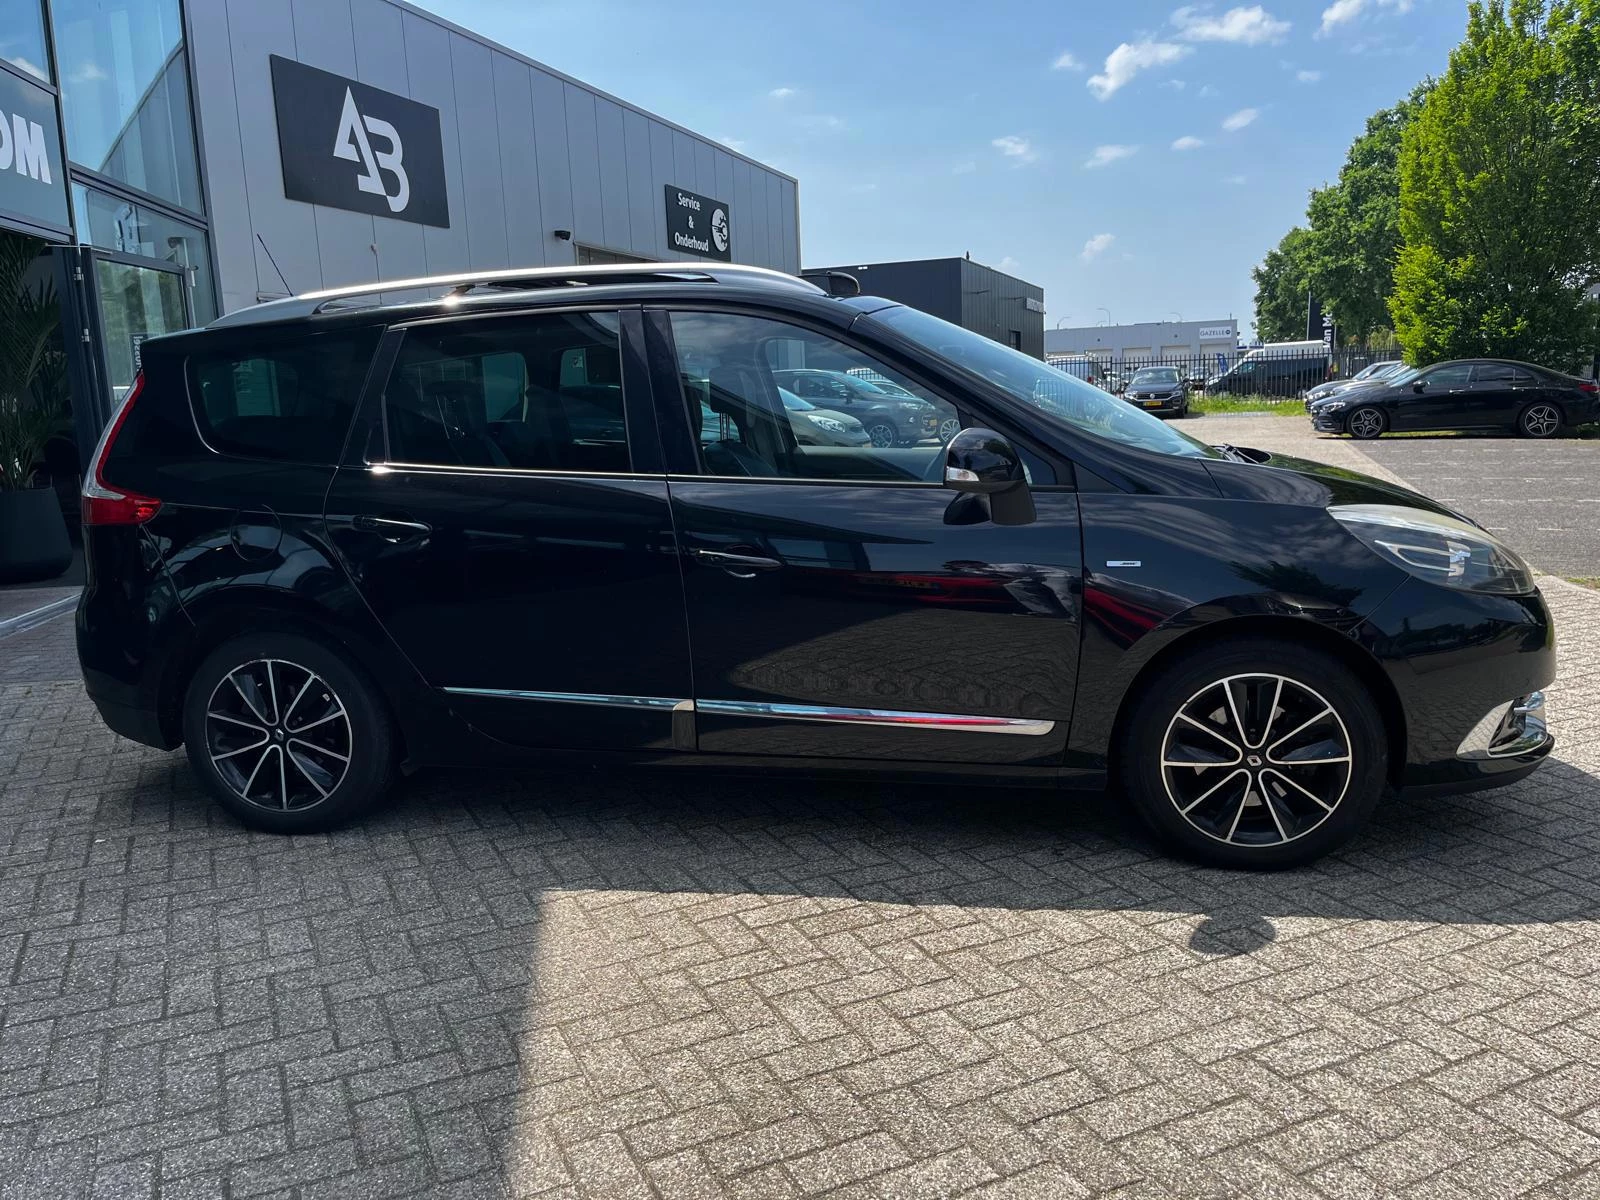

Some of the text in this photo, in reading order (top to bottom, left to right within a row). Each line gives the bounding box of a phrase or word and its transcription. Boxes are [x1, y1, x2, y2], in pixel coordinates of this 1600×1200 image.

[333, 85, 410, 213] AB
[678, 192, 700, 211] Service
[688, 215, 694, 229] &
[674, 231, 709, 252] Onderhoud
[1200, 329, 1225, 337] GAZELLE
